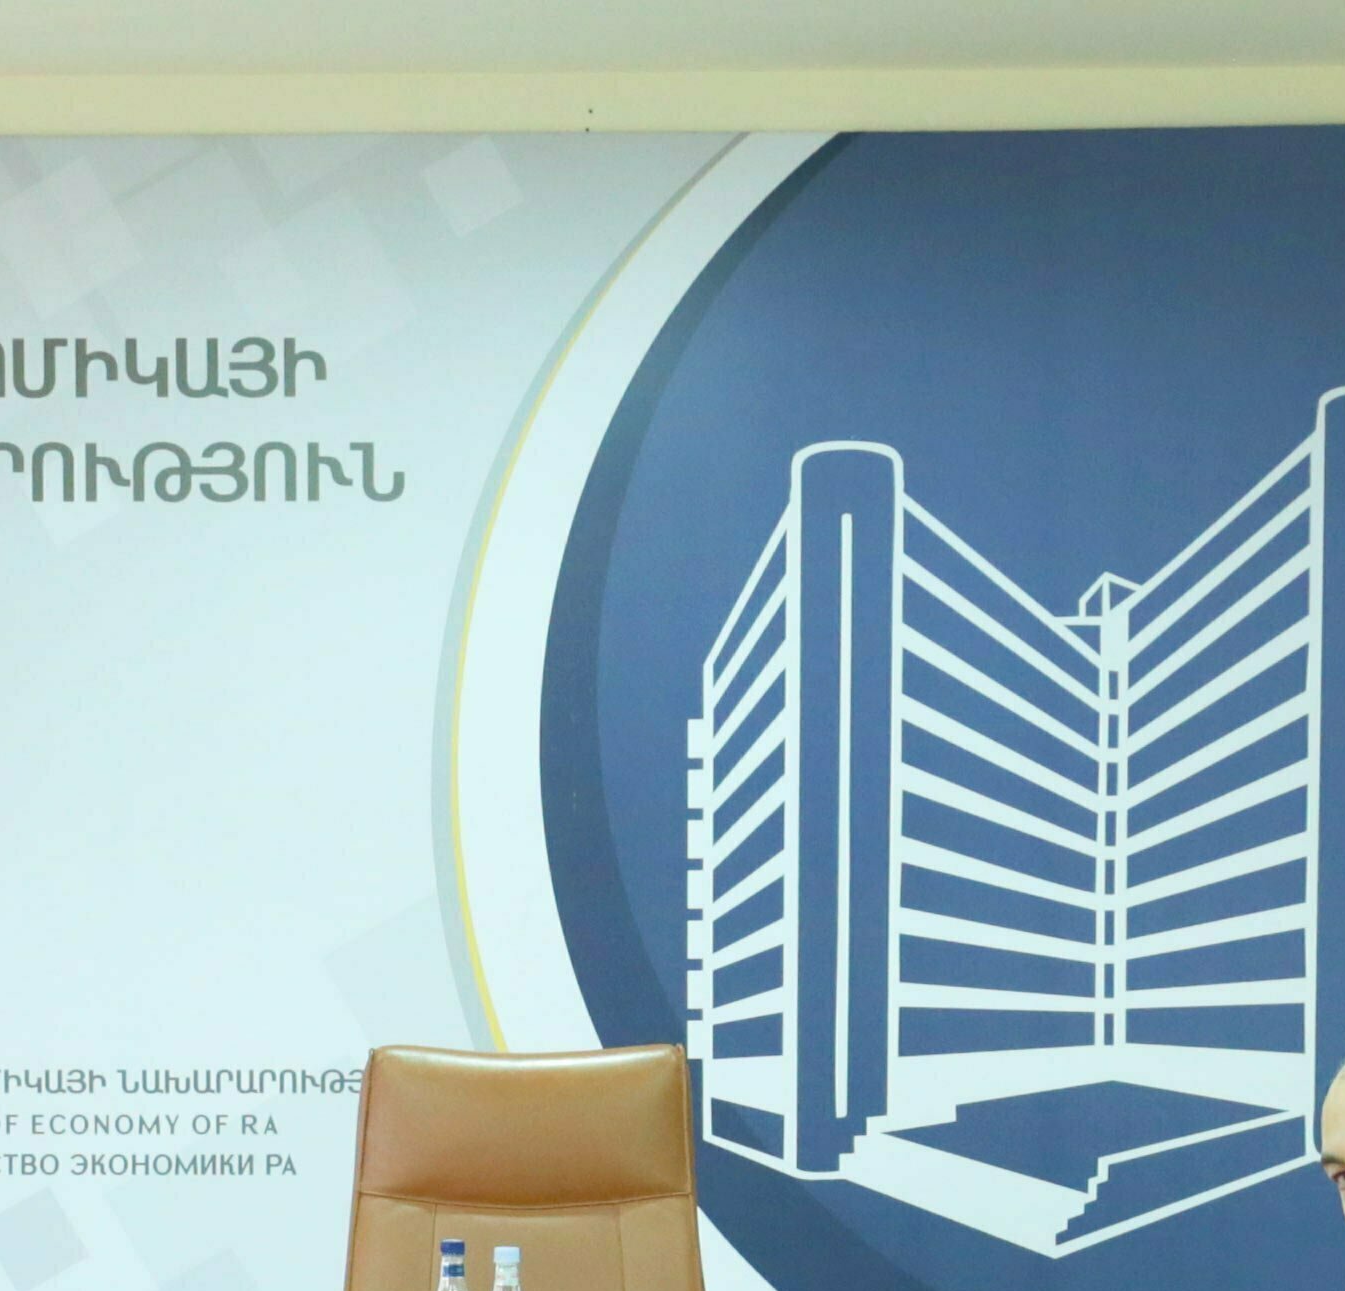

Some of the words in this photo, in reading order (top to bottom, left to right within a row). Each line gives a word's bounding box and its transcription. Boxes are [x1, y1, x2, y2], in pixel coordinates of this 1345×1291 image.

[31, 1113, 180, 1135] ECONOMY
[191, 1113, 229, 1135] OF
[241, 1113, 279, 1135] RA
[70, 1153, 254, 1176] ЭКОНОМИКИ
[265, 1153, 297, 1176] РА
